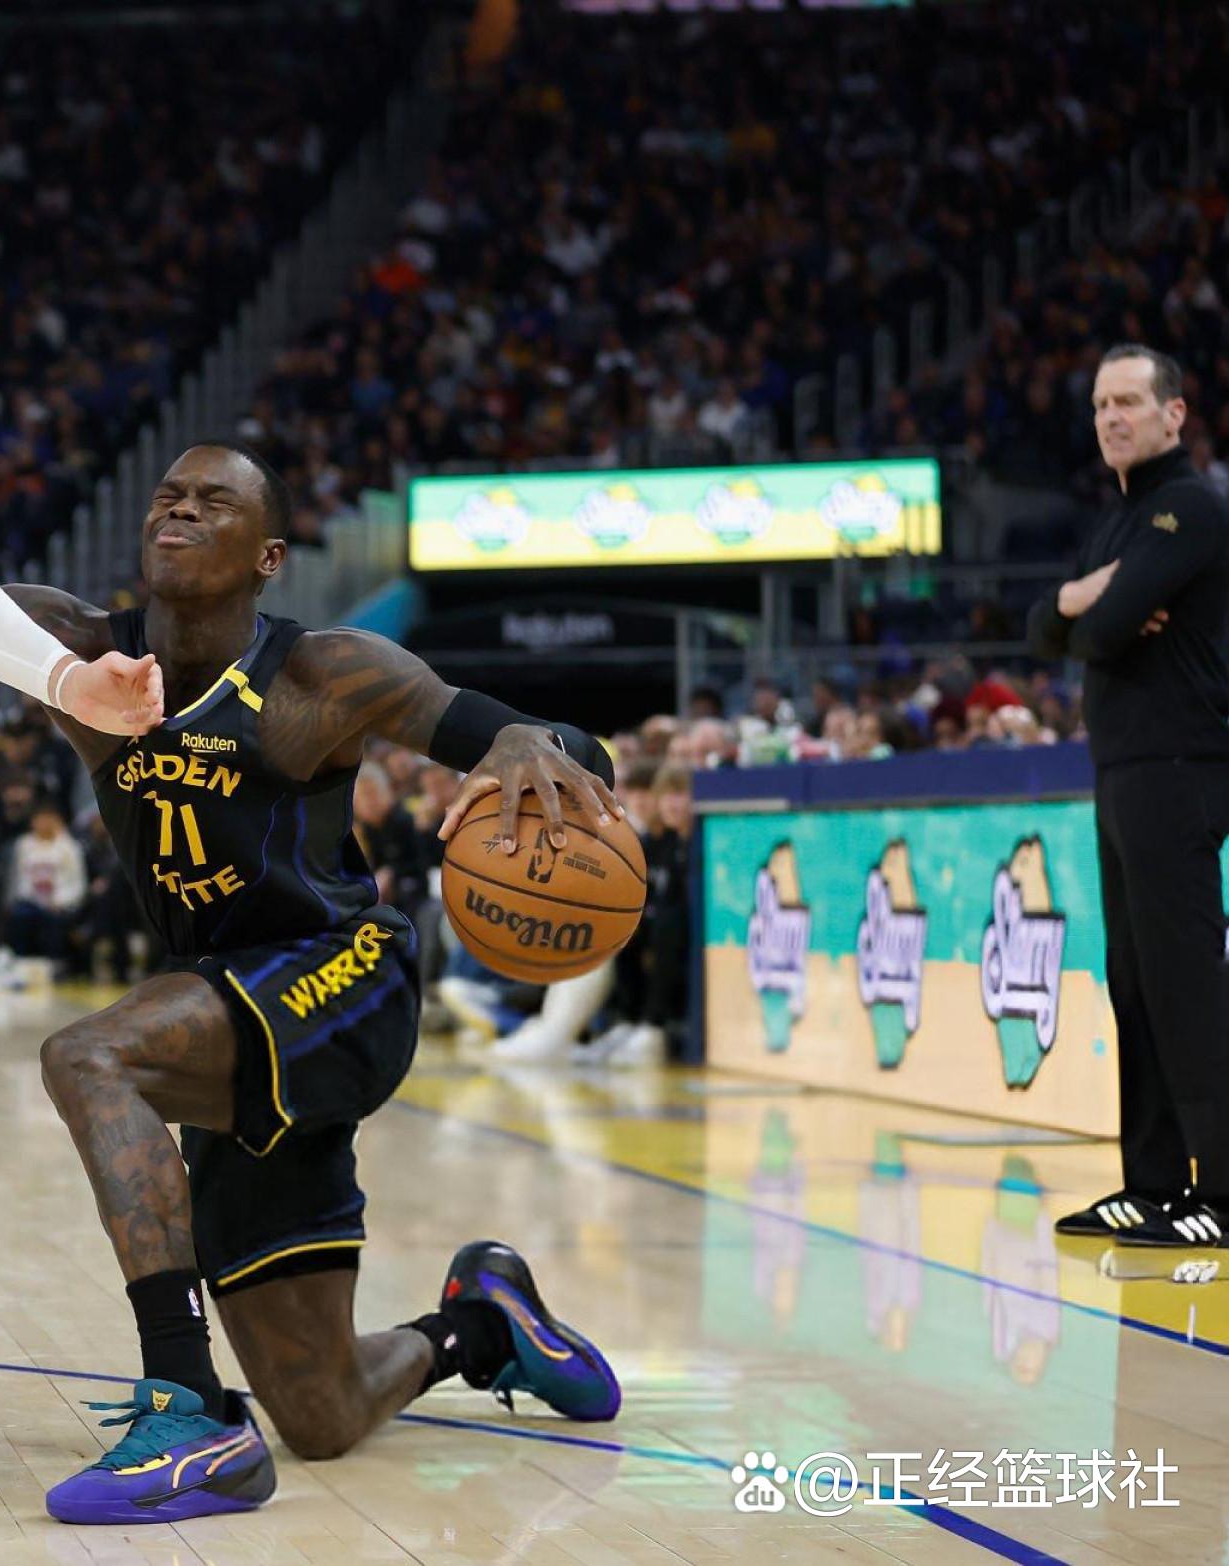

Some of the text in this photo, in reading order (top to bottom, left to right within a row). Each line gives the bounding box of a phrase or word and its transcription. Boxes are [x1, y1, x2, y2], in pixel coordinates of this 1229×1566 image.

[181, 732, 237, 752] Rakuten
[143, 791, 206, 865] 11
[465, 887, 594, 952] Wilson
